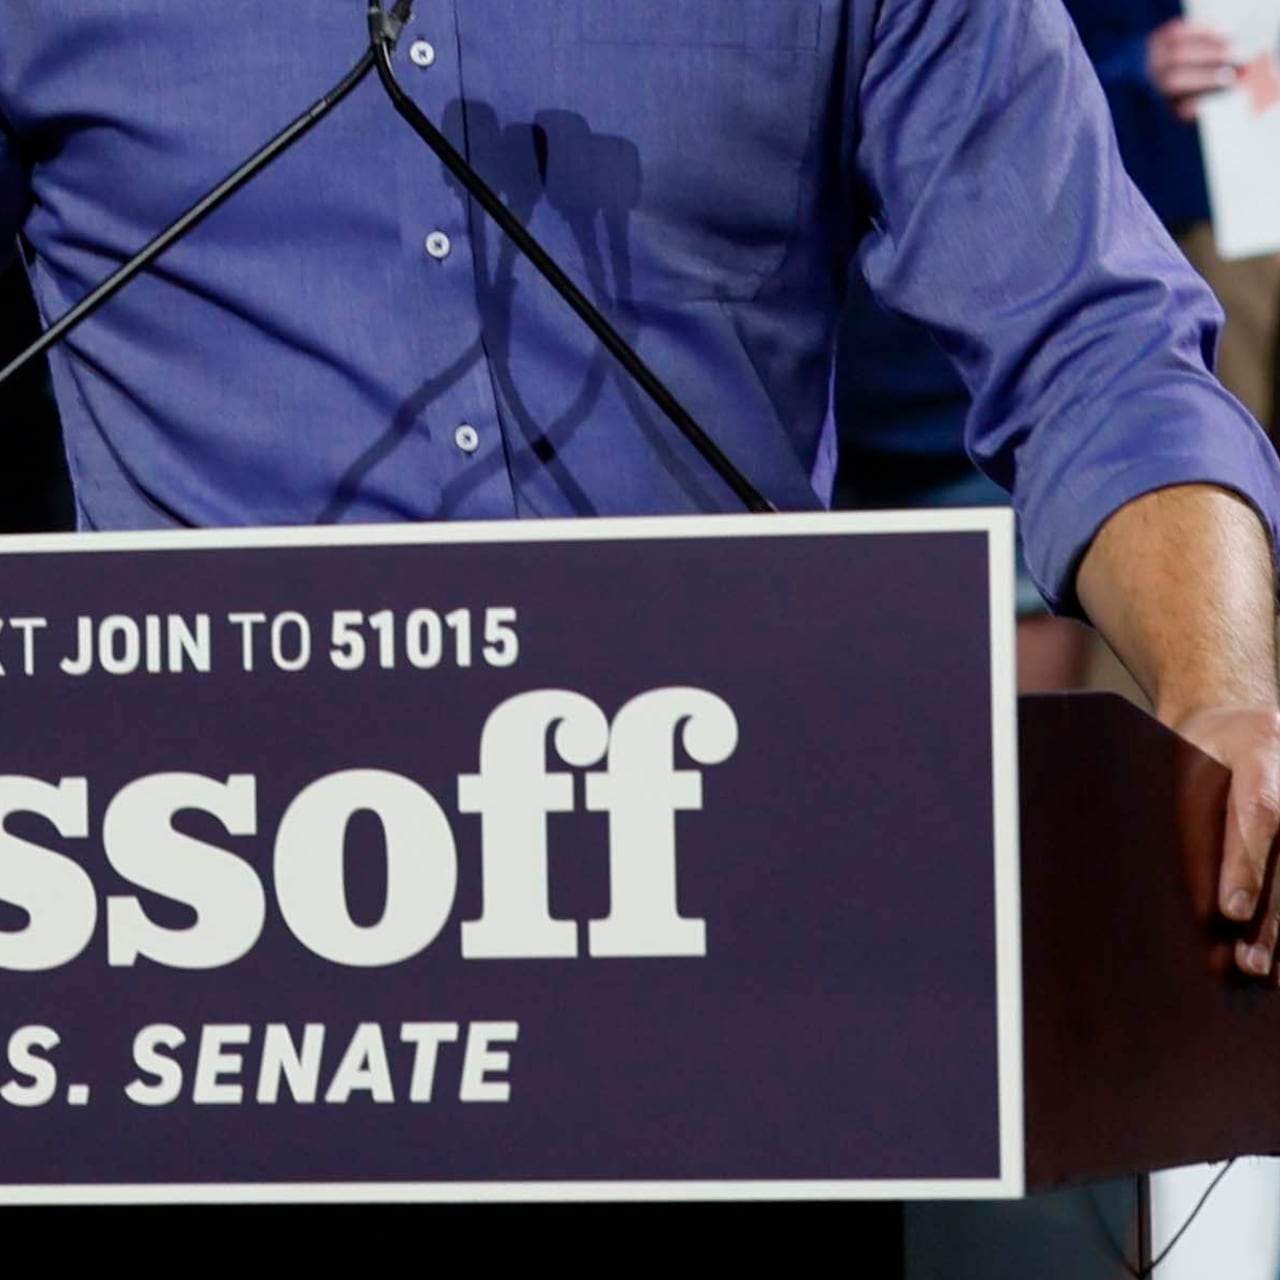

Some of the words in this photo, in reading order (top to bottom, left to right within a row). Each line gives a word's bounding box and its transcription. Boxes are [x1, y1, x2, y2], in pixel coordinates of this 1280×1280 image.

[60, 614, 210, 674] JOIN
[229, 612, 310, 670] TO
[330, 608, 518, 669] 51015
[125, 1022, 518, 1105] SENATE
